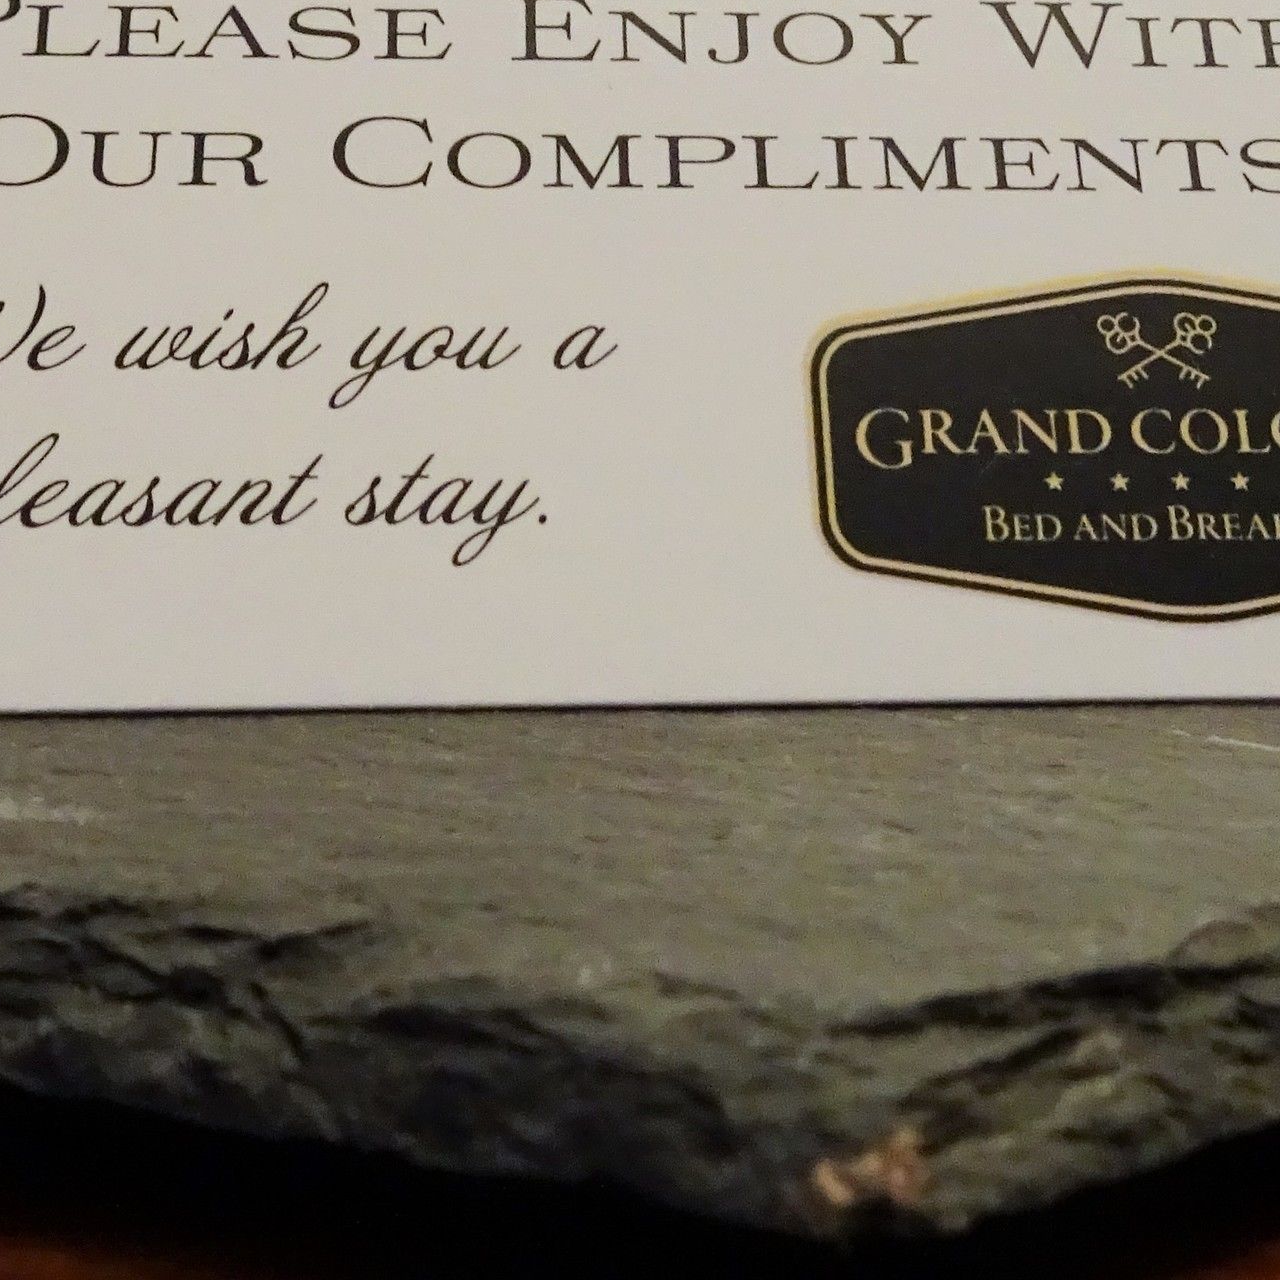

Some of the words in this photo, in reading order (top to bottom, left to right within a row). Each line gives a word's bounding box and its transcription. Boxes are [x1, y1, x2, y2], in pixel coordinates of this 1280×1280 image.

[115, 283, 328, 370] wish
[329, 327, 520, 409] you
[552, 325, 618, 370] a
[855, 406, 1113, 470] GRAND
[344, 455, 549, 567] stay.
[984, 505, 1063, 541] BED
[1073, 514, 1160, 541] AND
